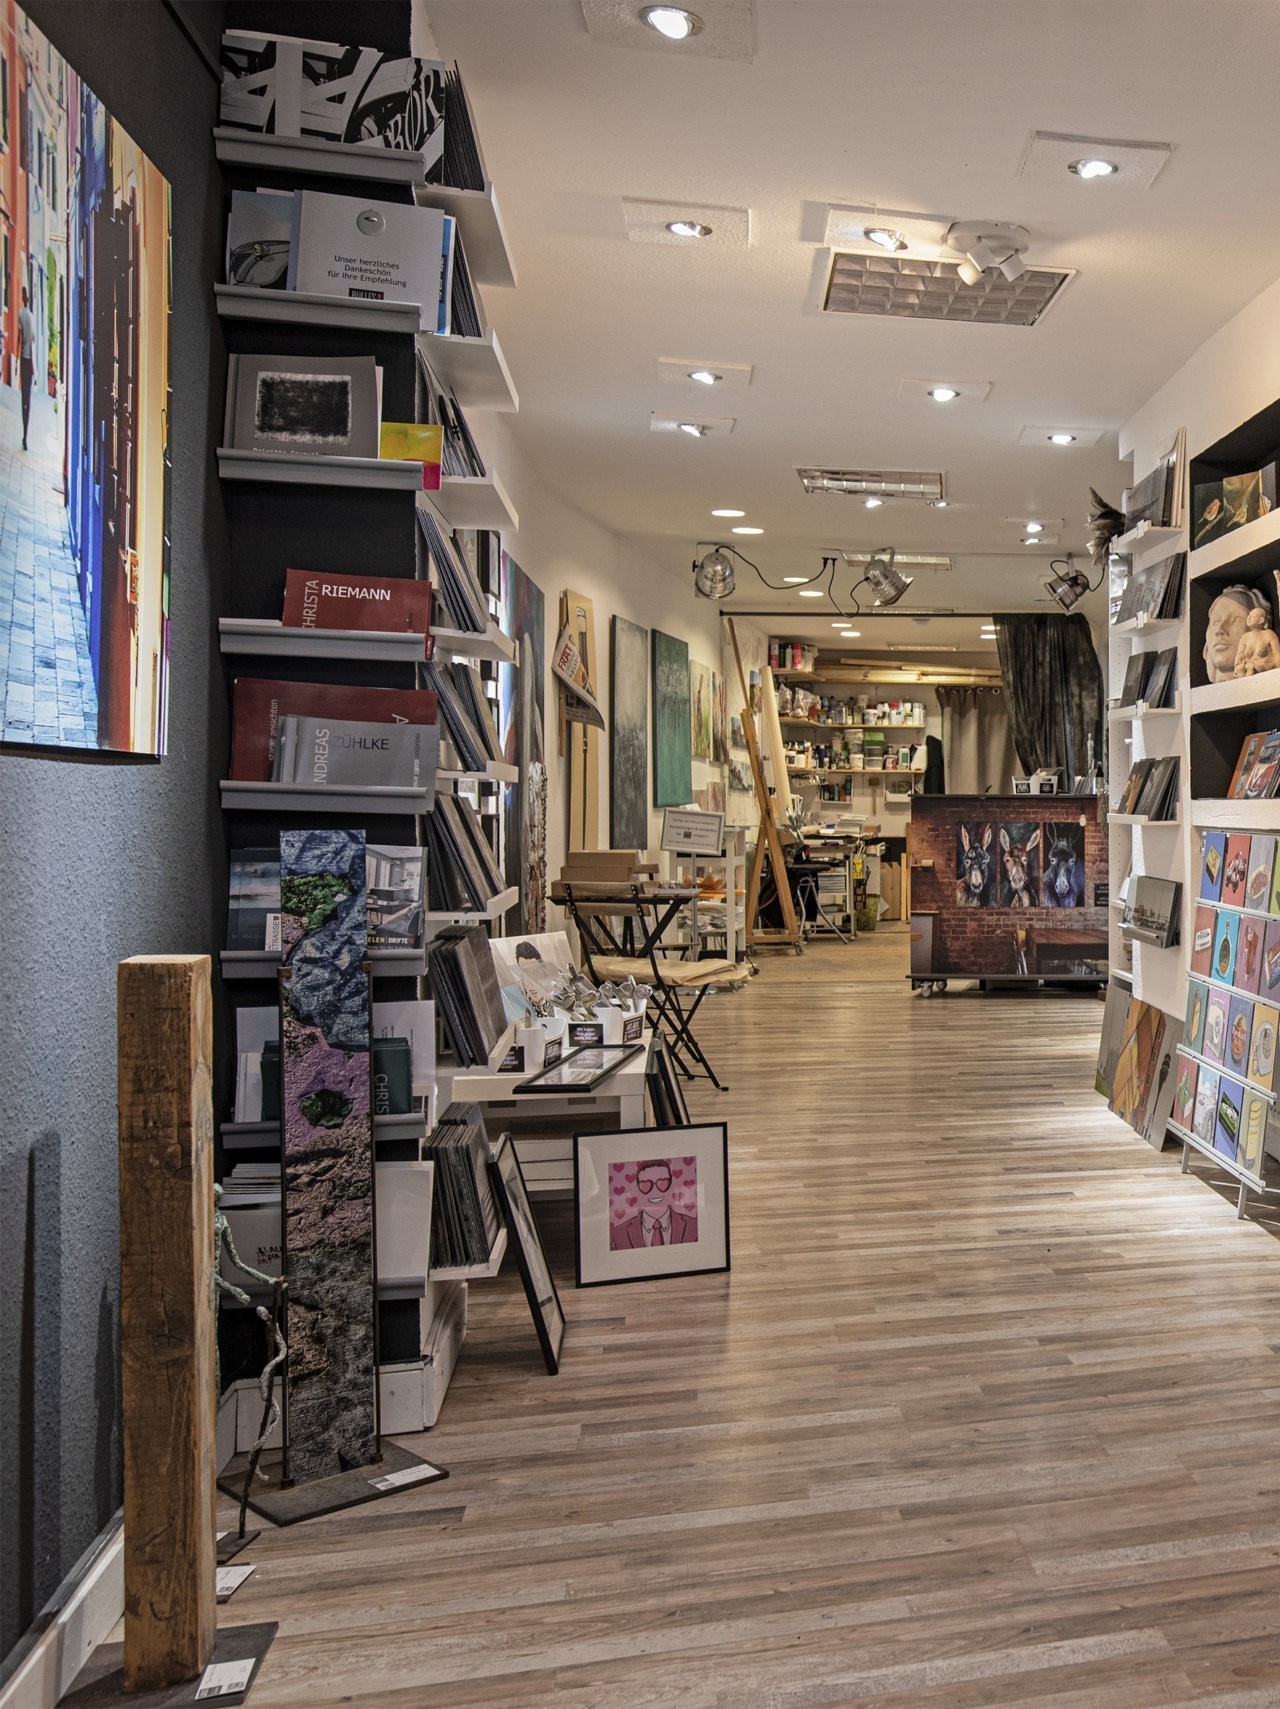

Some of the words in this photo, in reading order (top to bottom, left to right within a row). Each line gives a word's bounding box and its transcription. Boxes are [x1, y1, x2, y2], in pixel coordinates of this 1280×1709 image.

[334, 255, 357, 264] Unser
[360, 257, 400, 270] herzliches
[344, 264, 391, 277] Dankeschön
[328, 270, 339, 278] für
[342, 272, 358, 280] Ihre
[360, 274, 407, 288] Empfehlung
[322, 584, 391, 601] RIEMANN
[332, 735, 390, 750] ZÜHLKE
[313, 728, 330, 785] NDREAS
[375, 1074, 390, 1115] CHRIS
